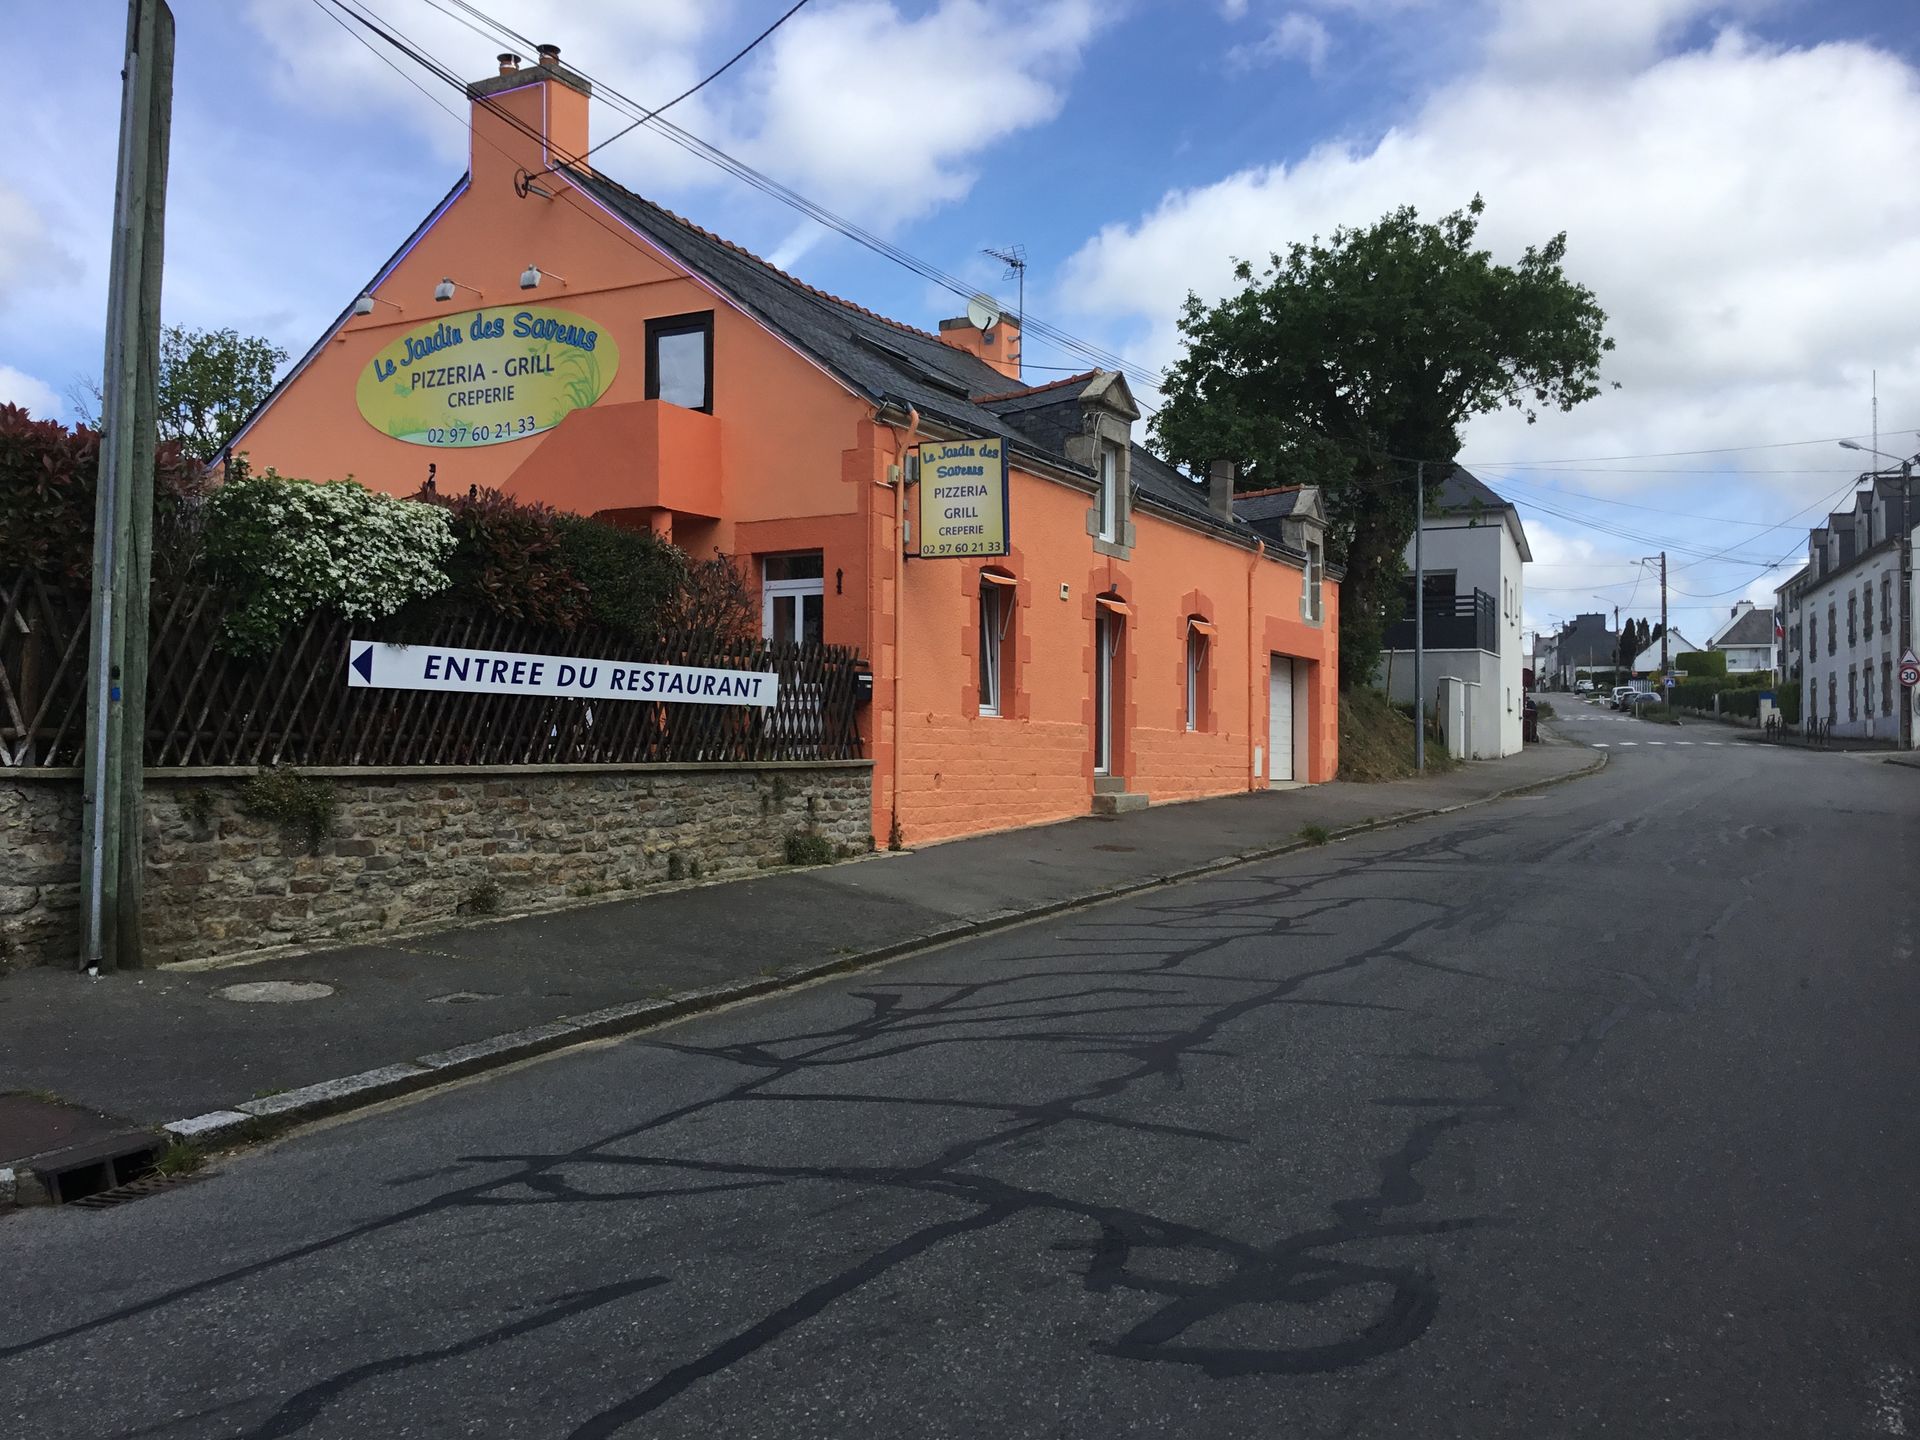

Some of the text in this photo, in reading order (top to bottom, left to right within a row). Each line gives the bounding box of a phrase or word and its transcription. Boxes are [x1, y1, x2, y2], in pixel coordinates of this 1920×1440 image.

[374, 312, 598, 382] Le Jardin des Saveurs
[411, 362, 486, 390] PIZZERIA
[504, 353, 555, 378] GRILL
[447, 385, 515, 408] CREPERIE
[427, 415, 535, 443] 02 97 60 21 33
[922, 443, 999, 464] Le Jardin des
[934, 485, 988, 499] PIZZERIA
[944, 507, 978, 519] GRILL
[938, 525, 984, 536] CREPERIE
[923, 542, 1001, 554] 02 97 60 21 33
[423, 654, 763, 698] ENTREE DU RESTAURANT
[1903, 671, 1916, 681] 30
